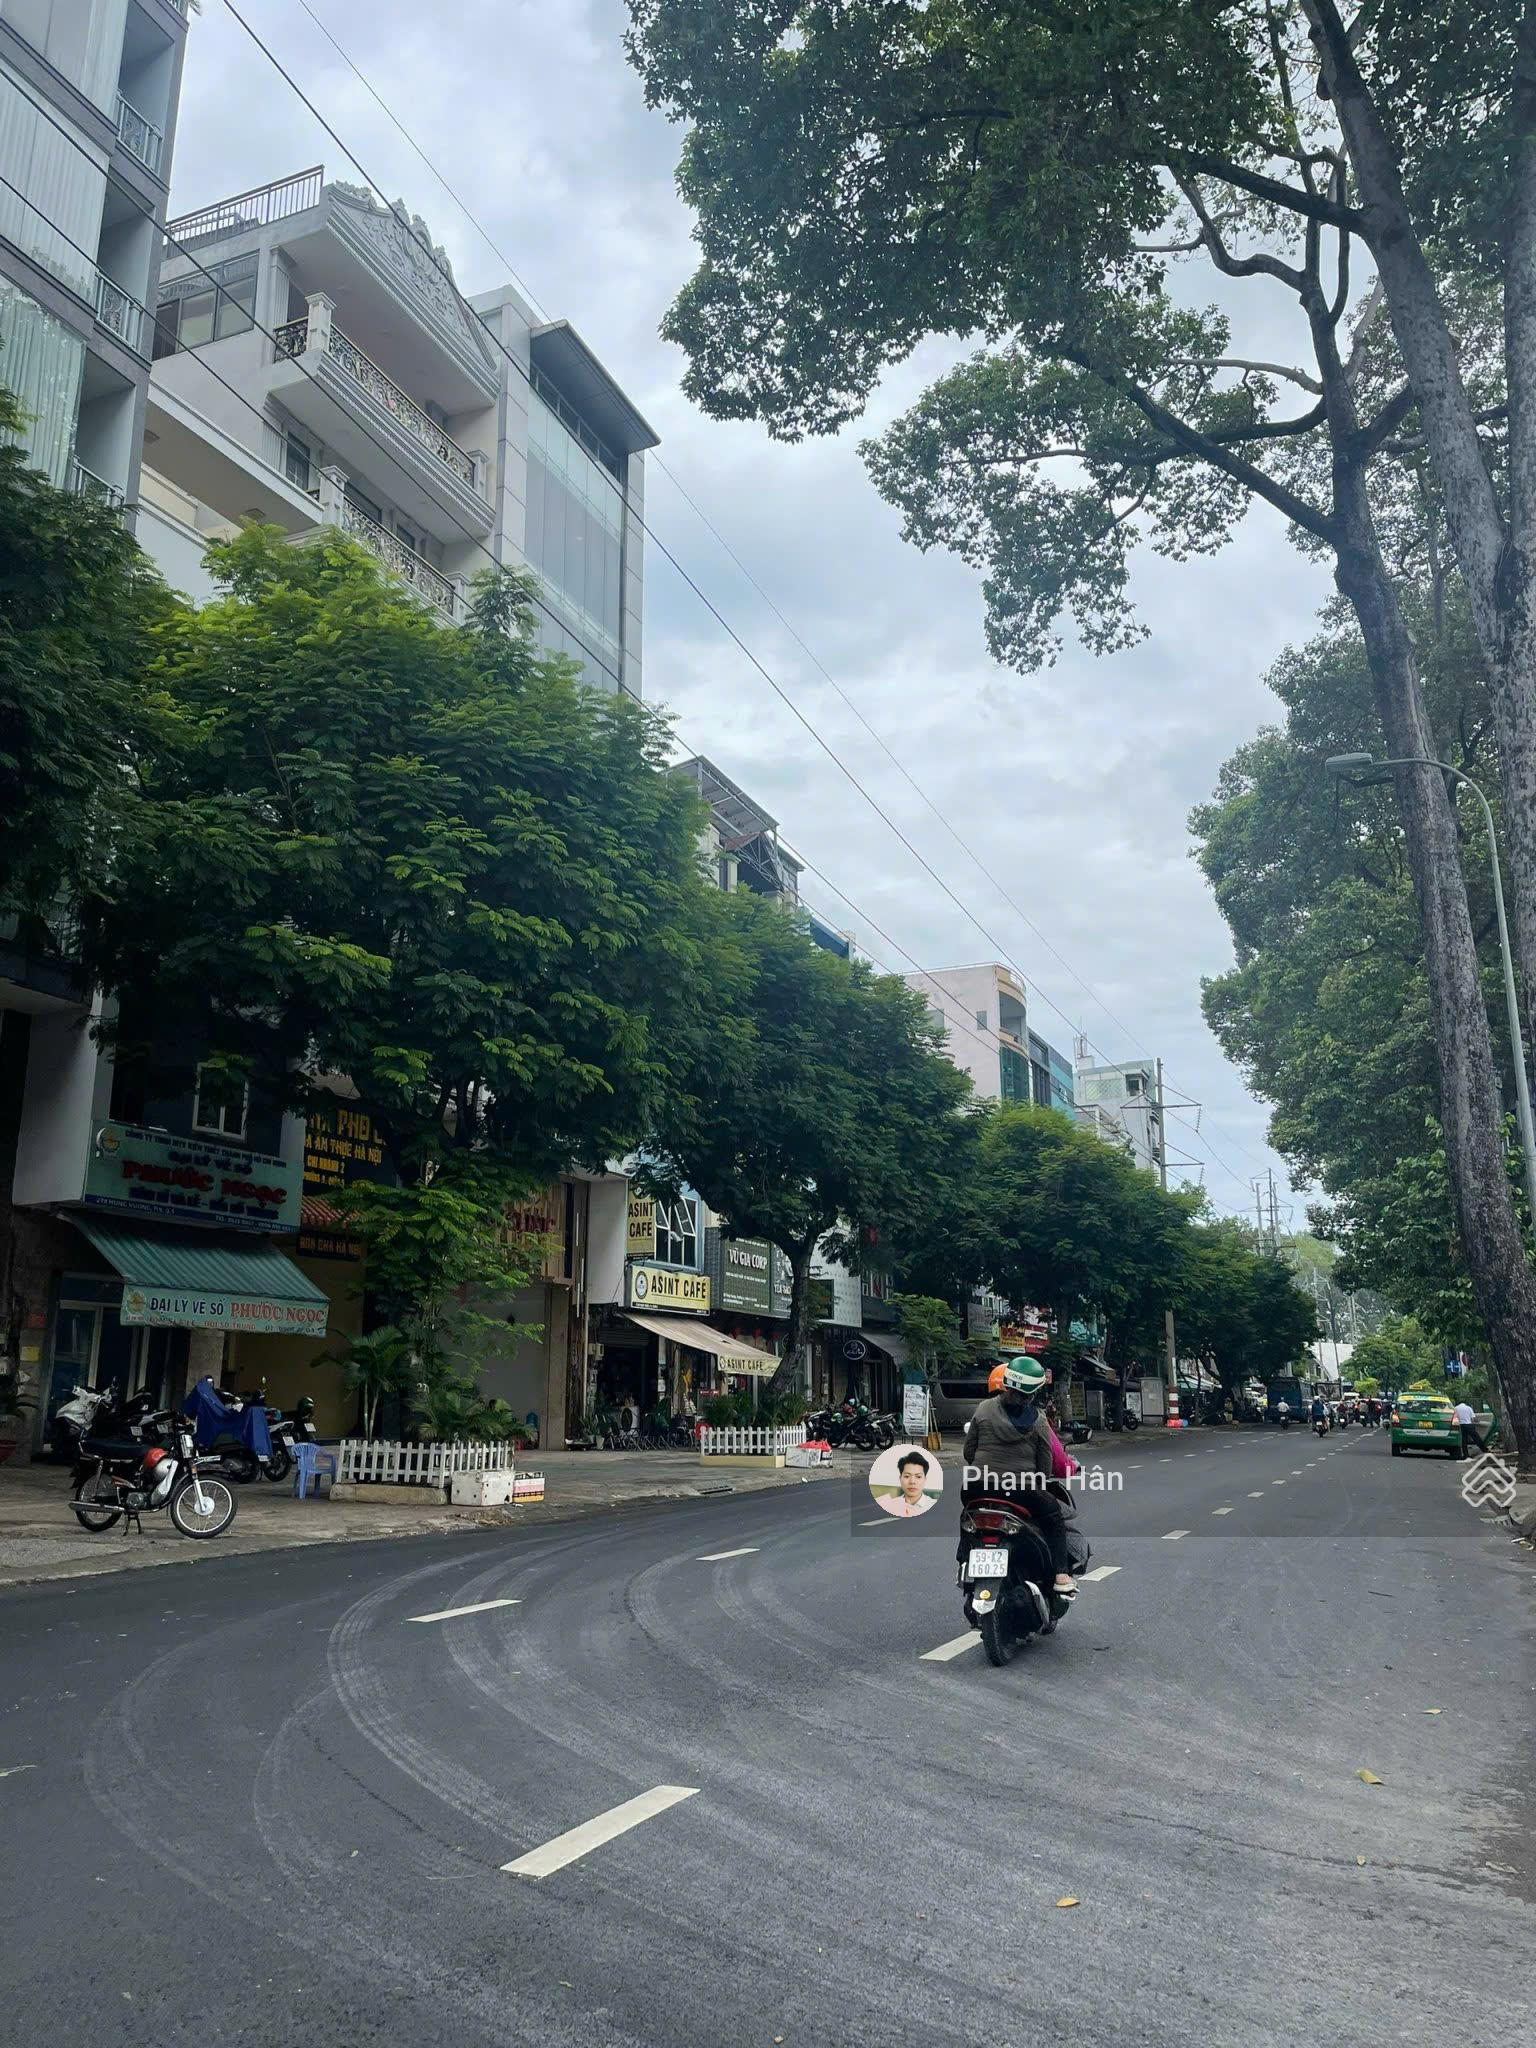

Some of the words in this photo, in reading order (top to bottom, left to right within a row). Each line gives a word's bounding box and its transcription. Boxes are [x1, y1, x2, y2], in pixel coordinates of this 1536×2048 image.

[628, 1201, 653, 1218] ASINT
[629, 1218, 653, 1238] CAFÉ
[729, 1247, 739, 1265] VŨ
[740, 1251, 751, 1267] GIA
[751, 1254, 768, 1270] CORP
[651, 1275, 680, 1296] ASINT
[683, 1278, 706, 1299] CAFÉ
[150, 1297, 171, 1315] ĐẠI
[209, 1297, 226, 1316] SỐ
[230, 1299, 282, 1321] PHƯỚC
[727, 1358, 745, 1370] ASINT
[972, 1564, 1005, 1576] 160.25
